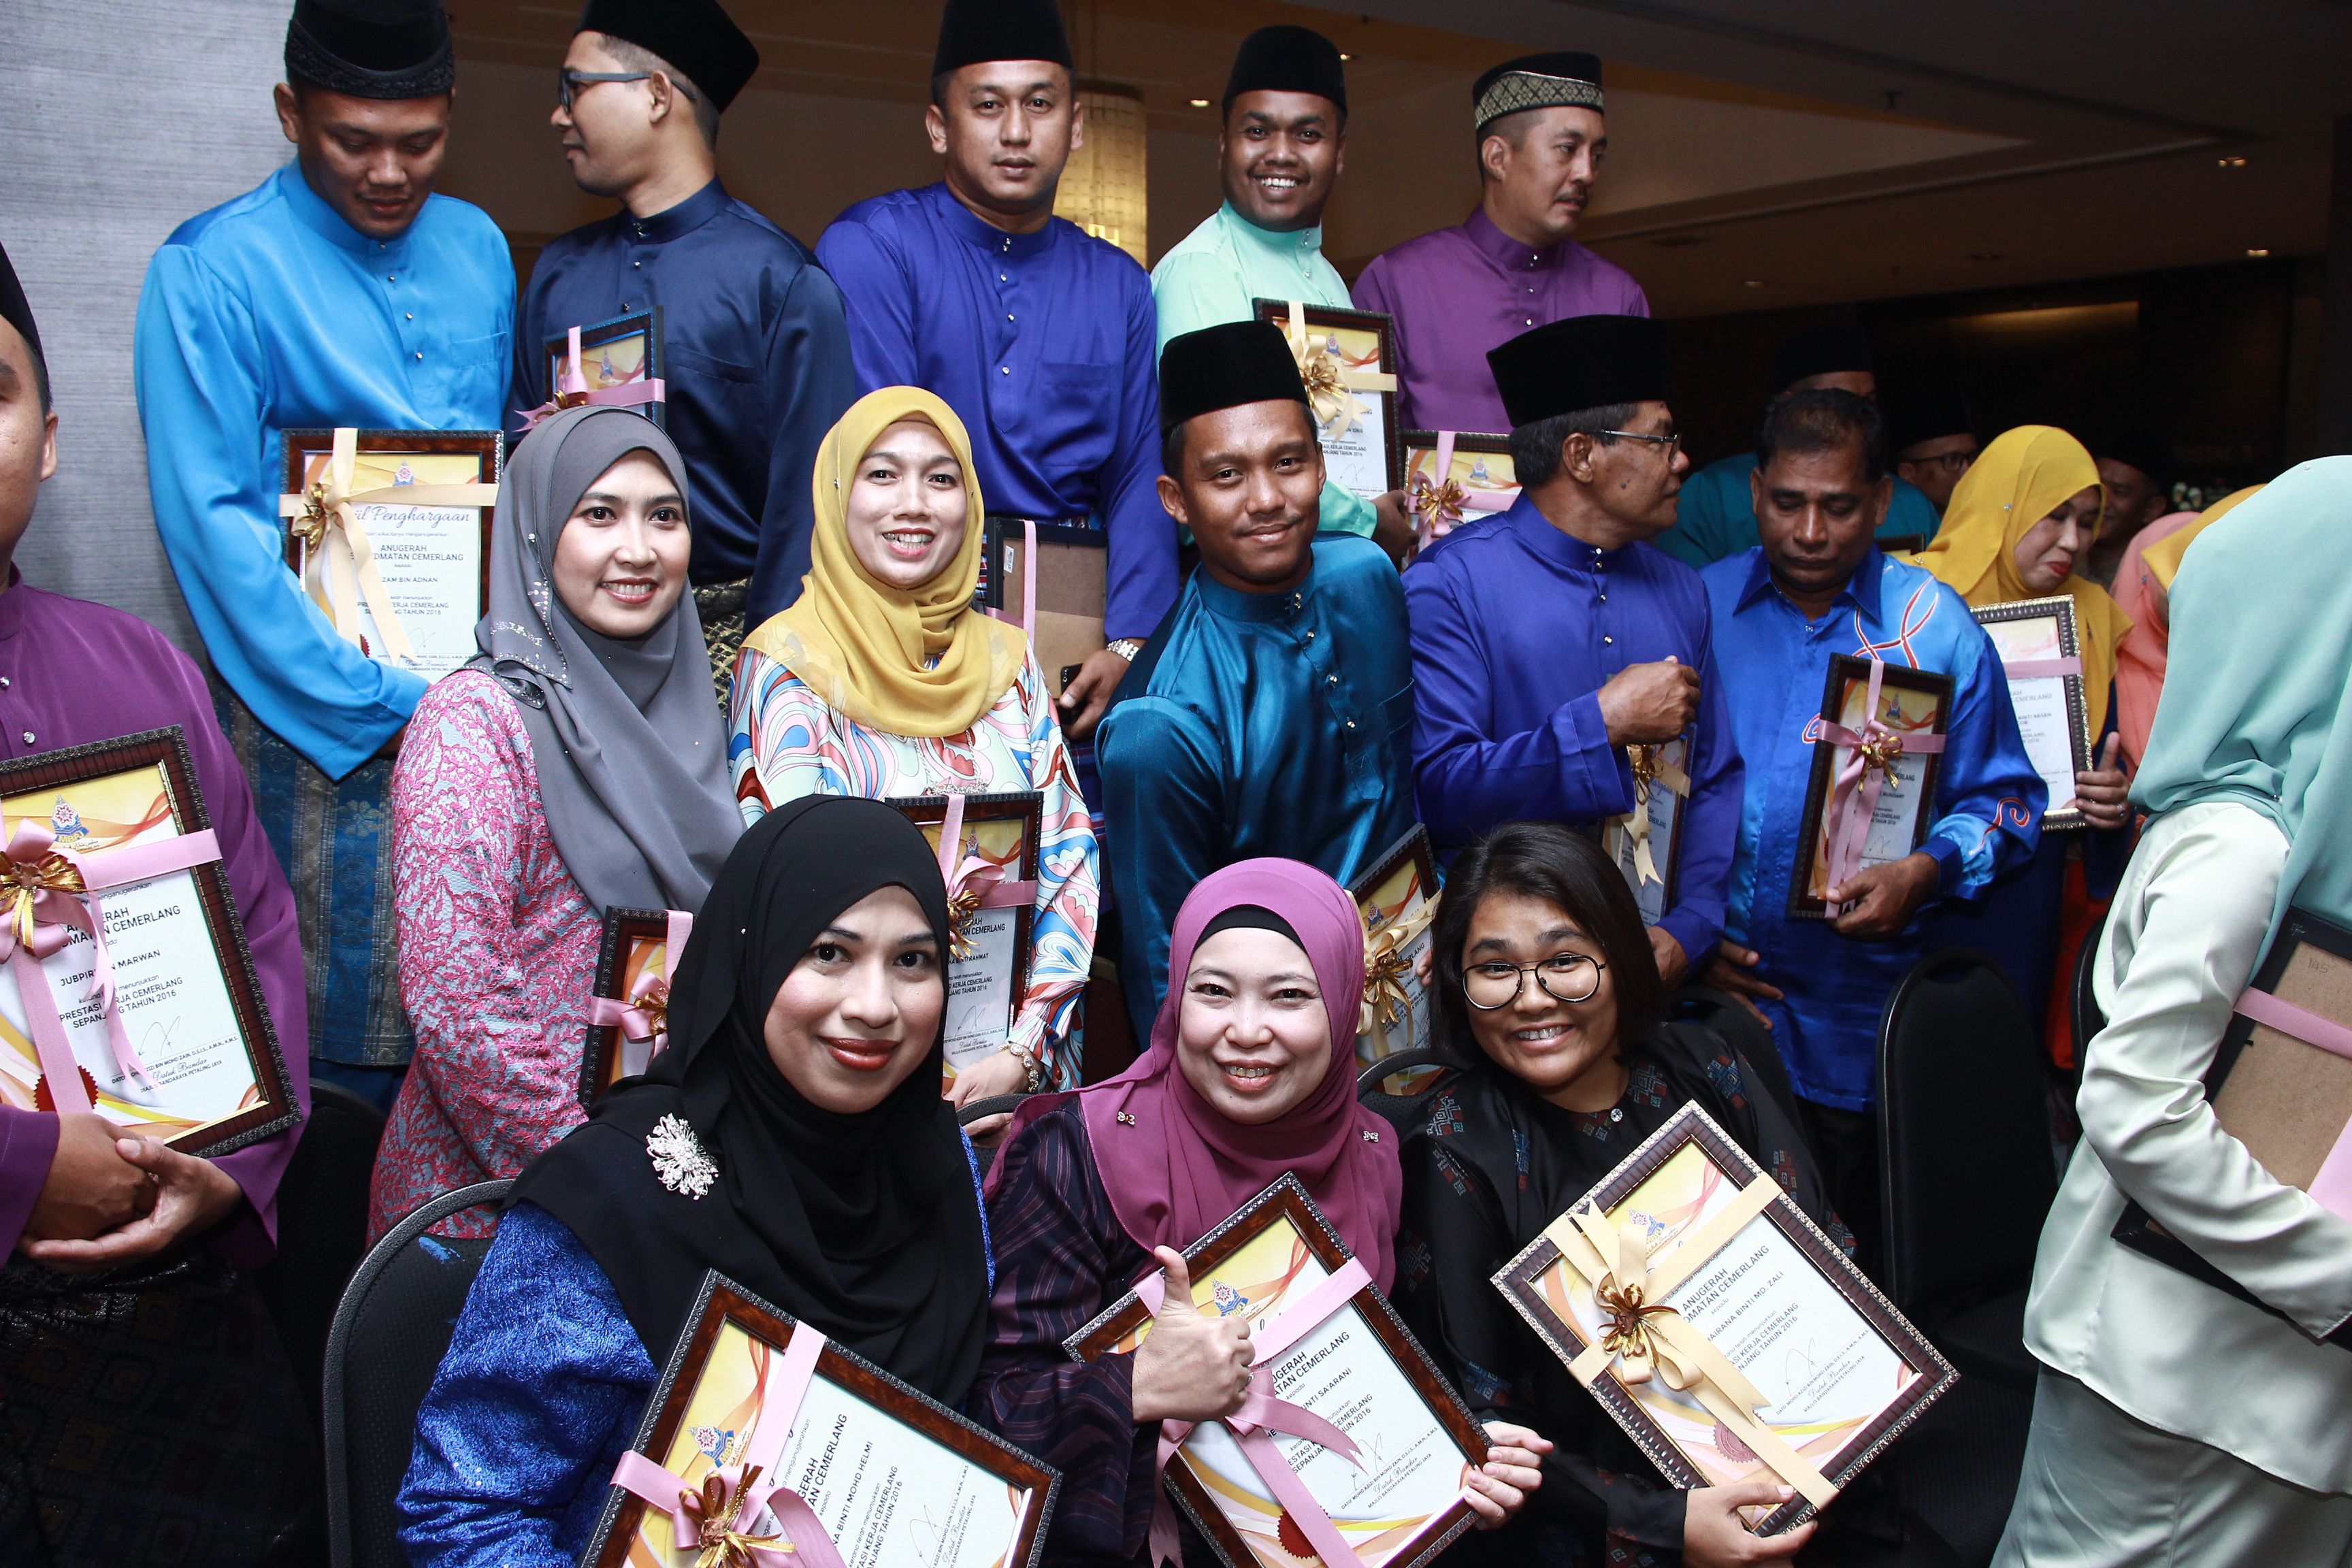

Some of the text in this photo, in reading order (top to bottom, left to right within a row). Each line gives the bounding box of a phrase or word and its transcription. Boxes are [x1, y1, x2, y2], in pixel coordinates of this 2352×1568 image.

[373, 506, 472, 528] Penghargaan
[2014, 693, 2051, 702] EMERLANG
[58, 828, 85, 845] MBPJ
[112, 904, 180, 932] CEMERLANG
[971, 924, 1005, 934] CEMERLANG
[59, 949, 161, 986] JUBPIR MARWAN
[1406, 943, 1426, 960] RLANG
[59, 1002, 101, 1022] PRESTASI
[132, 977, 183, 999] CEMERLANG
[127, 996, 154, 1011] TAHUN
[156, 988, 177, 1001] 2016
[966, 976, 992, 985] CEMERLANG
[1680, 1267, 1729, 1311] ANUGERAH
[1683, 1244, 1769, 1323] DMATAN CEMERLANG
[1707, 1271, 1784, 1341] AIRANA BINTI MD. ZALI
[1736, 1348, 1761, 1372] NJANG
[1759, 1329, 1782, 1351] TAHUN
[1780, 1315, 1798, 1331] 2016
[1740, 1302, 1798, 1356] KERJA CEMERLANG
[1269, 1351, 1307, 1384] UGERAH
[1295, 1331, 1350, 1377] CEMERLANG
[1286, 1382, 1305, 1400] kepada
[1301, 1394, 1319, 1411] INTI
[1317, 1367, 1352, 1397] SA'ARANI
[1324, 1399, 1352, 1422] nunjukkan
[719, 1435, 736, 1465] MBPJ
[784, 1418, 811, 1480] menganugerahkan
[814, 1413, 847, 1486] CEMERLANG
[1287, 1393, 1373, 1466] ESTASI CEMERLANG
[1292, 1406, 1371, 1473] SEPANJA HUN 2016
[796, 1456, 819, 1499] GERAH
[836, 1504, 851, 1531] BINTI
[846, 1471, 862, 1503] MOHD
[858, 1441, 873, 1471] HELMI
[817, 1489, 832, 1516] kepada
[862, 1482, 882, 1526] menunjukkan
[863, 1465, 898, 1550] KERJA CEMERLANG
[867, 1480, 902, 1567] NJANG TAHUN 2016
